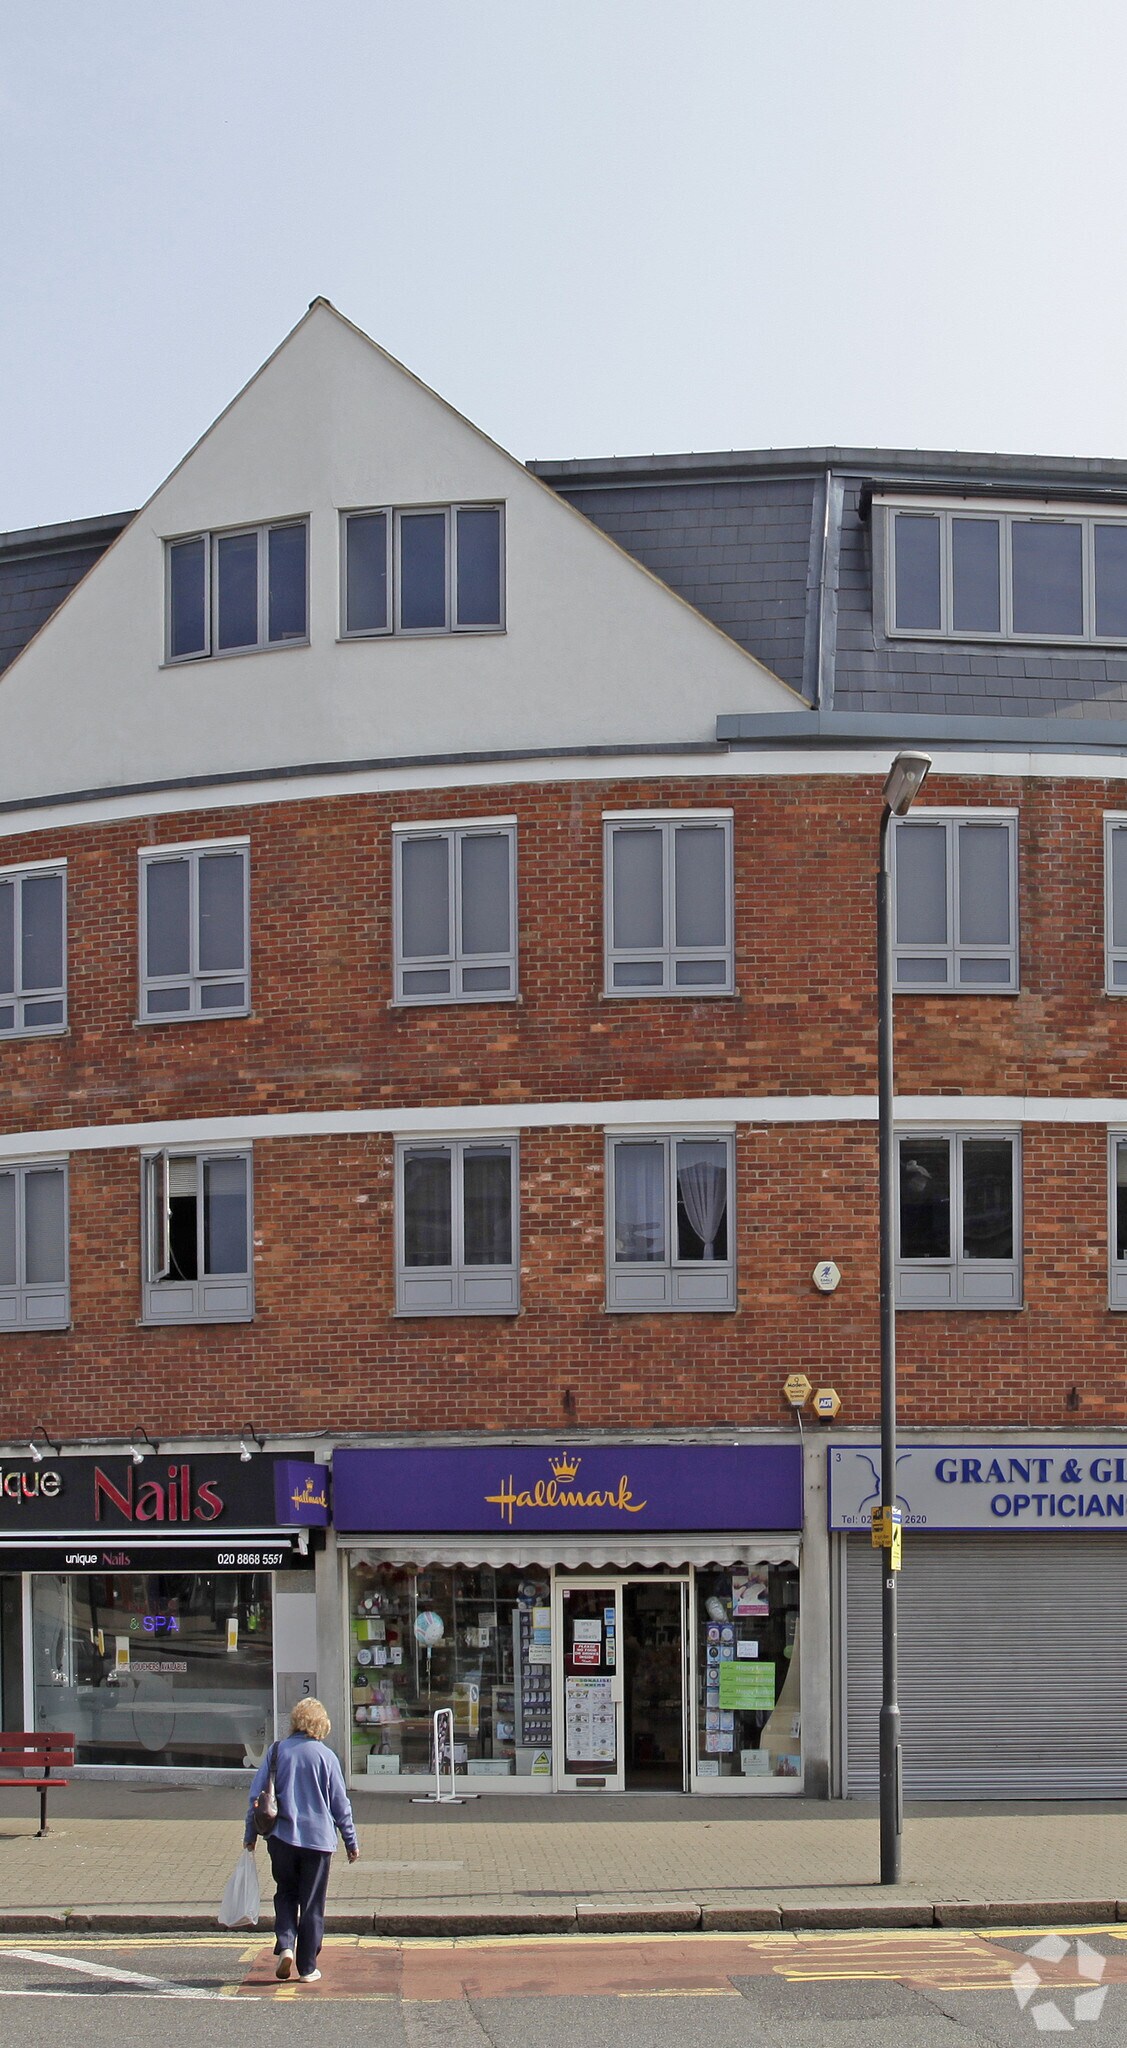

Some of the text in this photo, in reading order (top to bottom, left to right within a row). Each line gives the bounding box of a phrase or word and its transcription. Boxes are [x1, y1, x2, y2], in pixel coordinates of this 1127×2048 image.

[820, 1399, 832, 1407] ADT
[835, 1453, 842, 1462] 3
[934, 1458, 1054, 1483] GRANT
[1060, 1458, 1083, 1483] &
[94, 1464, 224, 1521] Nails
[291, 1486, 328, 1511] Hallmark
[484, 1474, 648, 1525] Hallmark
[990, 1493, 1127, 1517] OPTICIAN
[841, 1514, 858, 1524] Tel:
[861, 1515, 872, 1524] 02
[904, 1515, 927, 1524] 2620
[65, 1552, 283, 1566] unique Nails 020 8868 5551
[887, 1580, 894, 1588] 5
[130, 1615, 179, 1632] & SPA
[161, 1662, 187, 1671] AVAILABLE
[302, 1679, 310, 1695] 5
